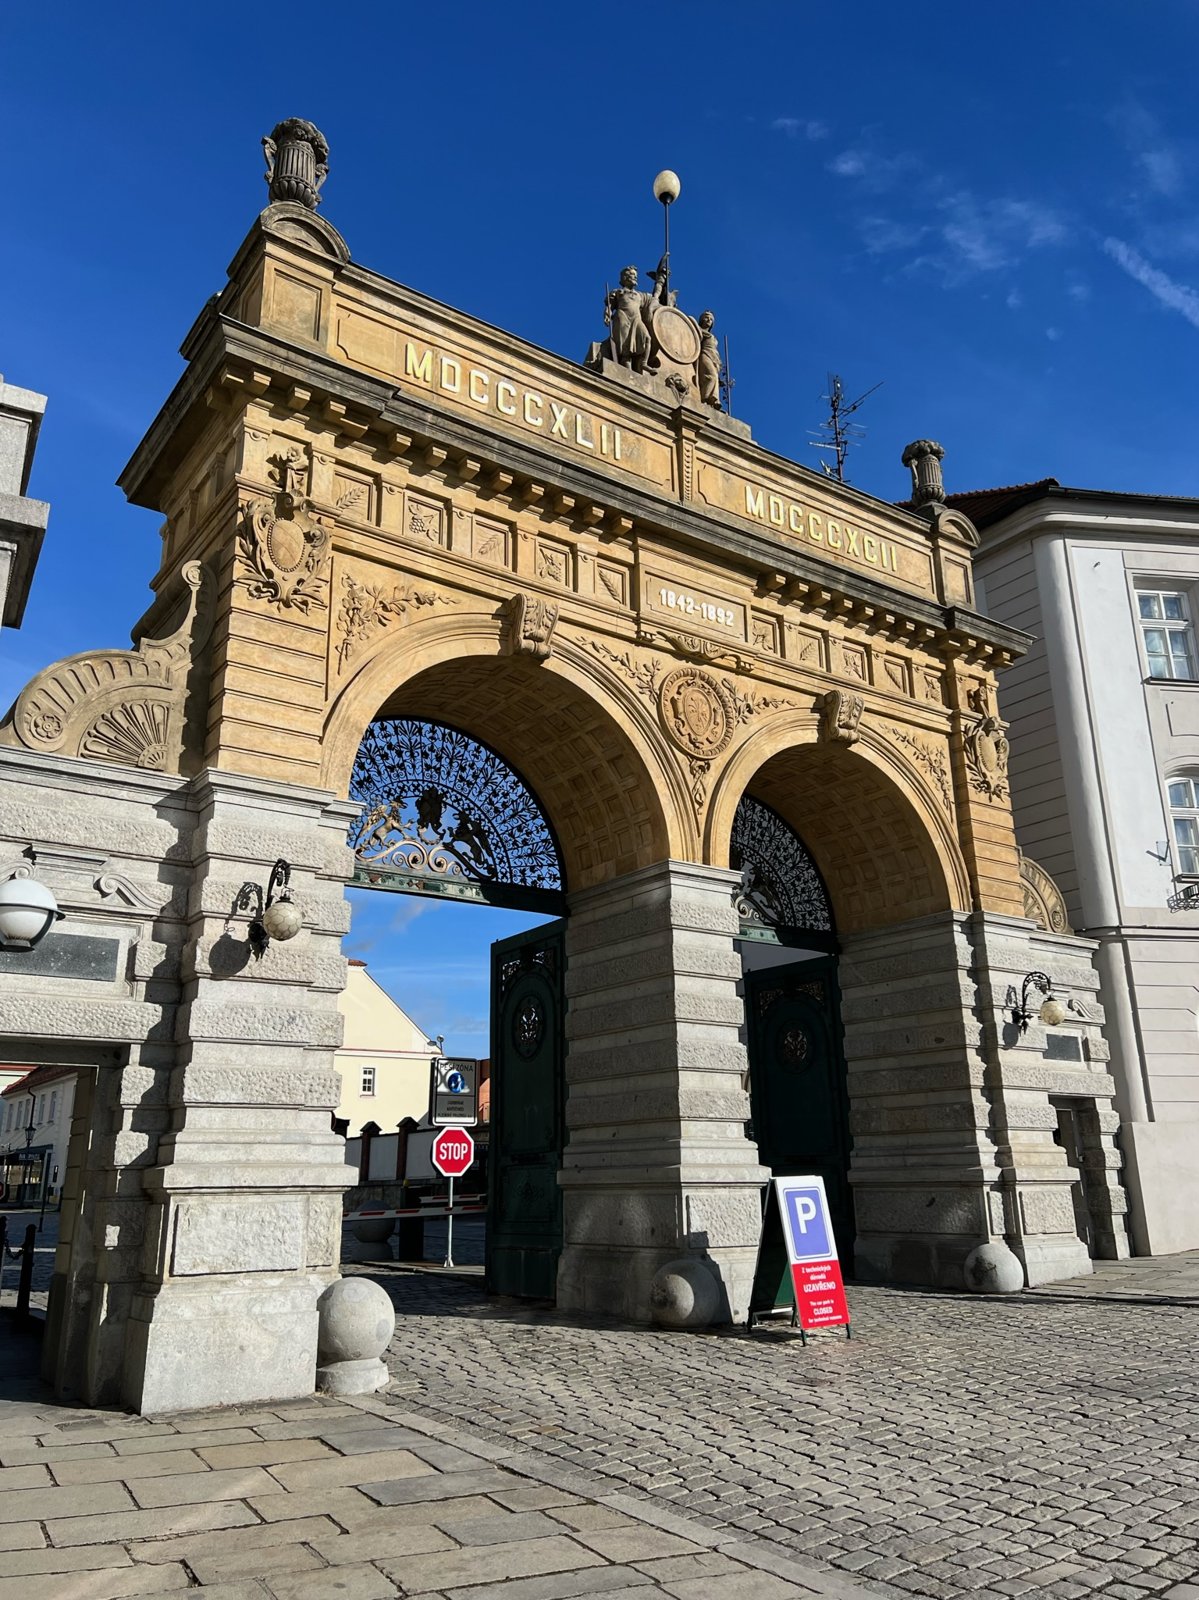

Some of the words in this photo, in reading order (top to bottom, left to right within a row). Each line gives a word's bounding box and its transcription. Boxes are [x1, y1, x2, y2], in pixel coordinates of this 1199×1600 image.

[405, 342, 621, 460] MDCCCXLII
[745, 485, 898, 572] MDCCCXCII
[659, 588, 735, 627] 1842-1892
[440, 1142, 468, 1160] STOP
[794, 1196, 817, 1234] P
[803, 1281, 836, 1293] UZAVŘENO
[813, 1306, 833, 1316] CLOSED
